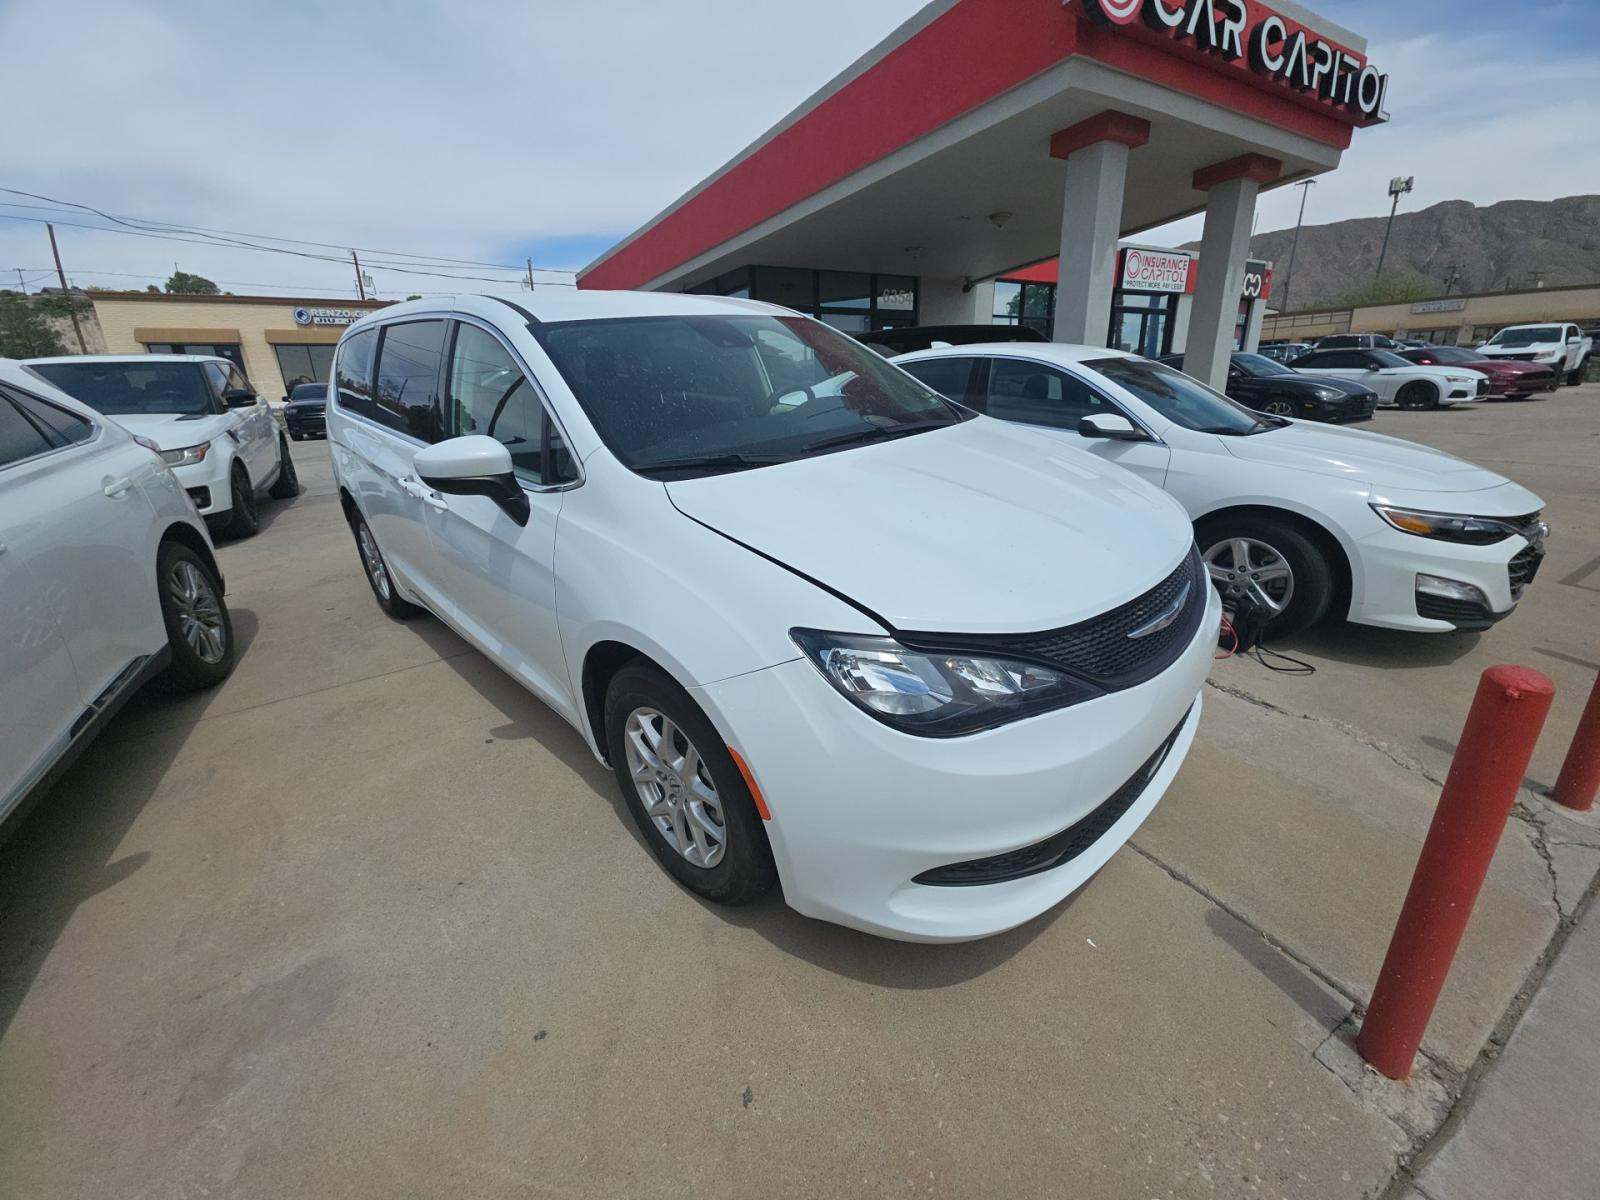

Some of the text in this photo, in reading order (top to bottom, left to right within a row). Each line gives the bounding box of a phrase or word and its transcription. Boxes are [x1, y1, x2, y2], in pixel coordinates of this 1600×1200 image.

[1260, 15, 1390, 122] CAPITOL
[1141, 255, 1188, 271] INSURANCE
[1141, 268, 1185, 282] CAPITOL
[883, 289, 913, 304] 6354
[311, 309, 351, 318] RENZO
